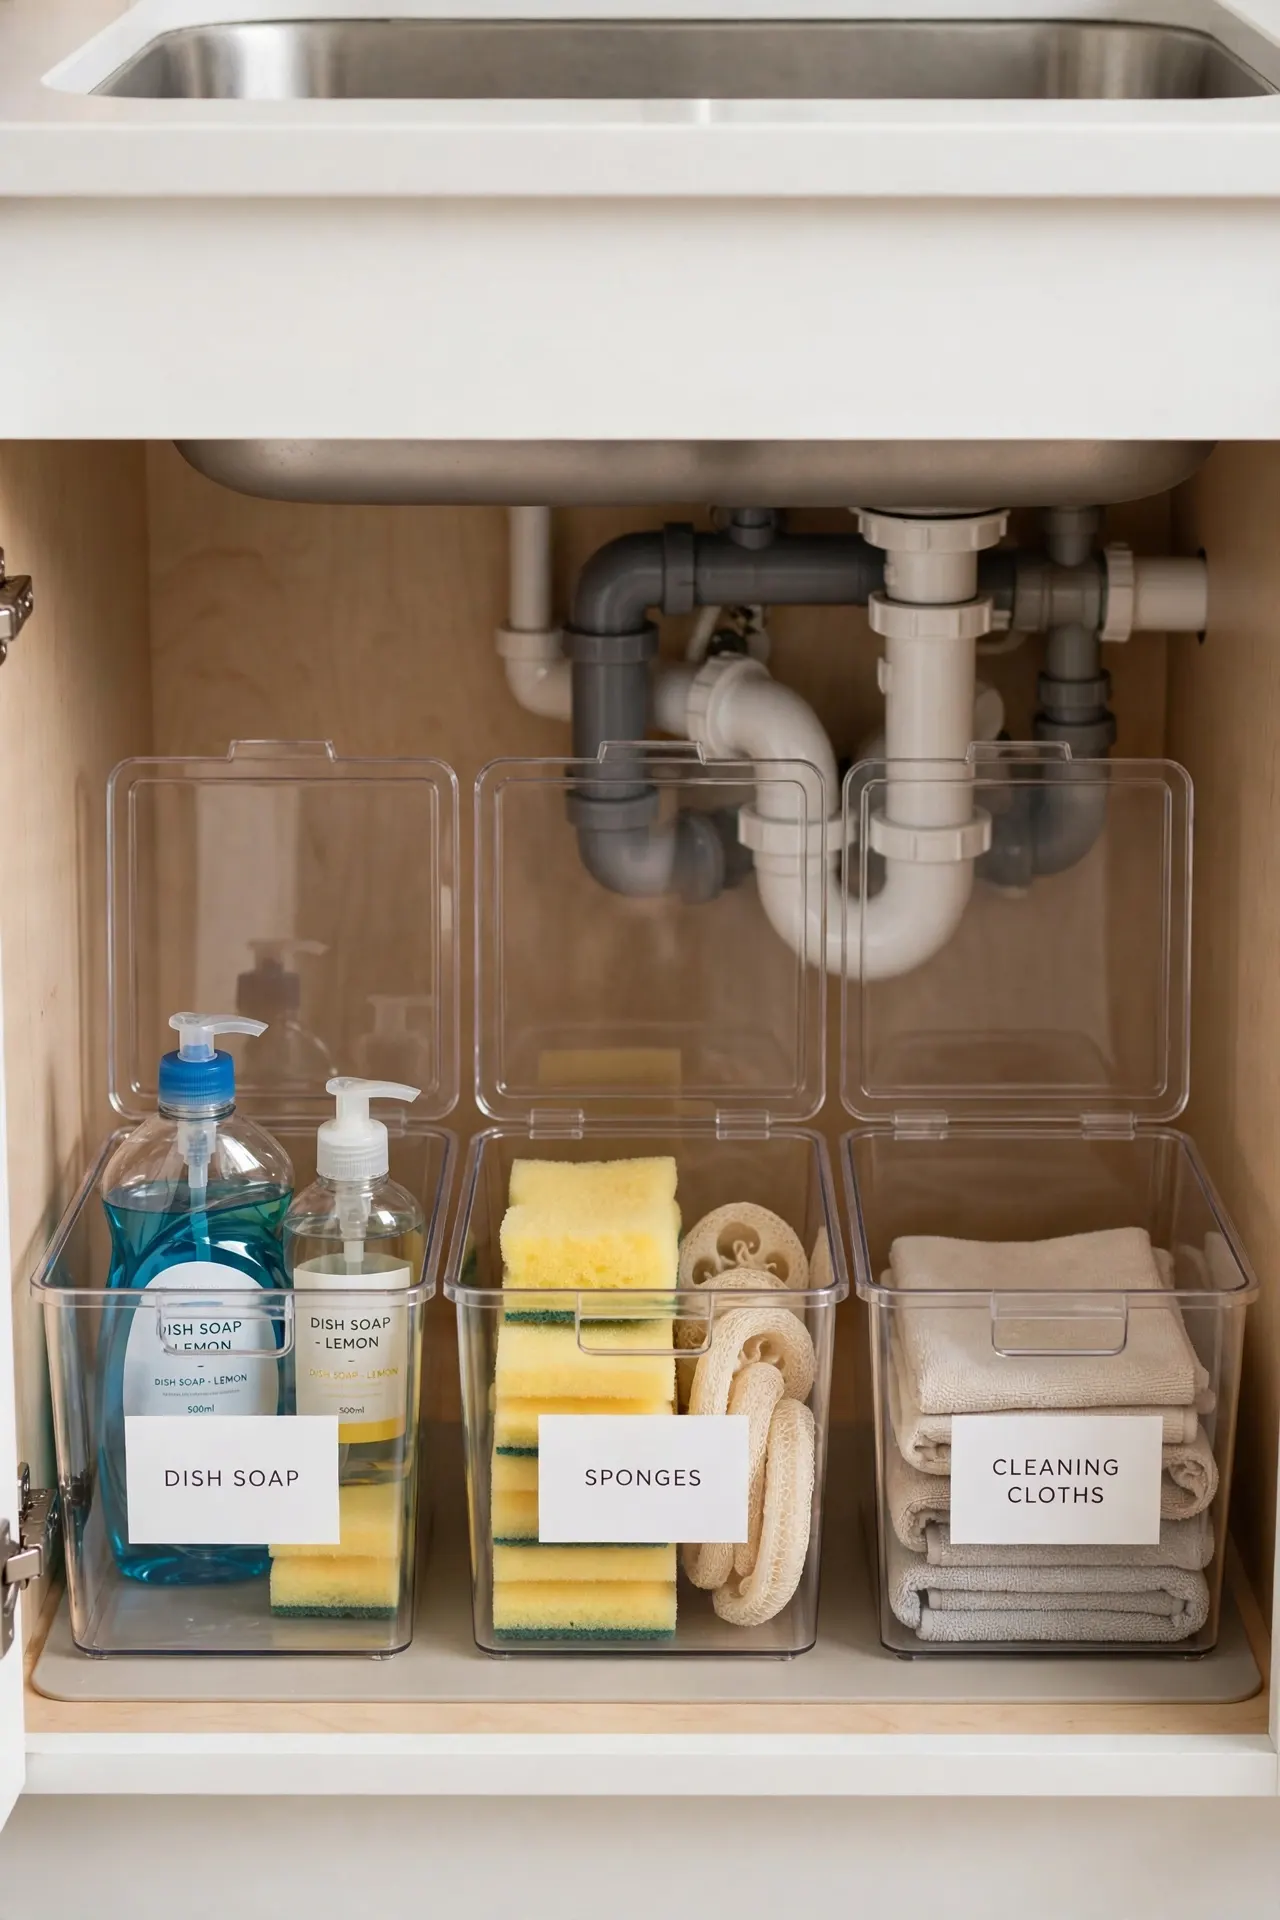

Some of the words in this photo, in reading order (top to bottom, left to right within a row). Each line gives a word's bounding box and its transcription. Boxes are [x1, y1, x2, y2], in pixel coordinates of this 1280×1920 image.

[199, 1320, 242, 1335] SOAP
[310, 1317, 344, 1331] DISH
[350, 1316, 391, 1331] SOAP
[326, 1336, 379, 1349] LEMON
[154, 1377, 176, 1387] DISH
[179, 1377, 205, 1387] SOAP
[213, 1373, 248, 1386] LEMON
[187, 1404, 215, 1414] 500ml
[338, 1406, 365, 1414] 500ml
[992, 1457, 1120, 1477] CLEANING
[165, 1469, 222, 1487] DISH
[233, 1469, 299, 1487] SOAP
[585, 1468, 702, 1488] SPONGES
[1007, 1485, 1105, 1505] CLOTHS
